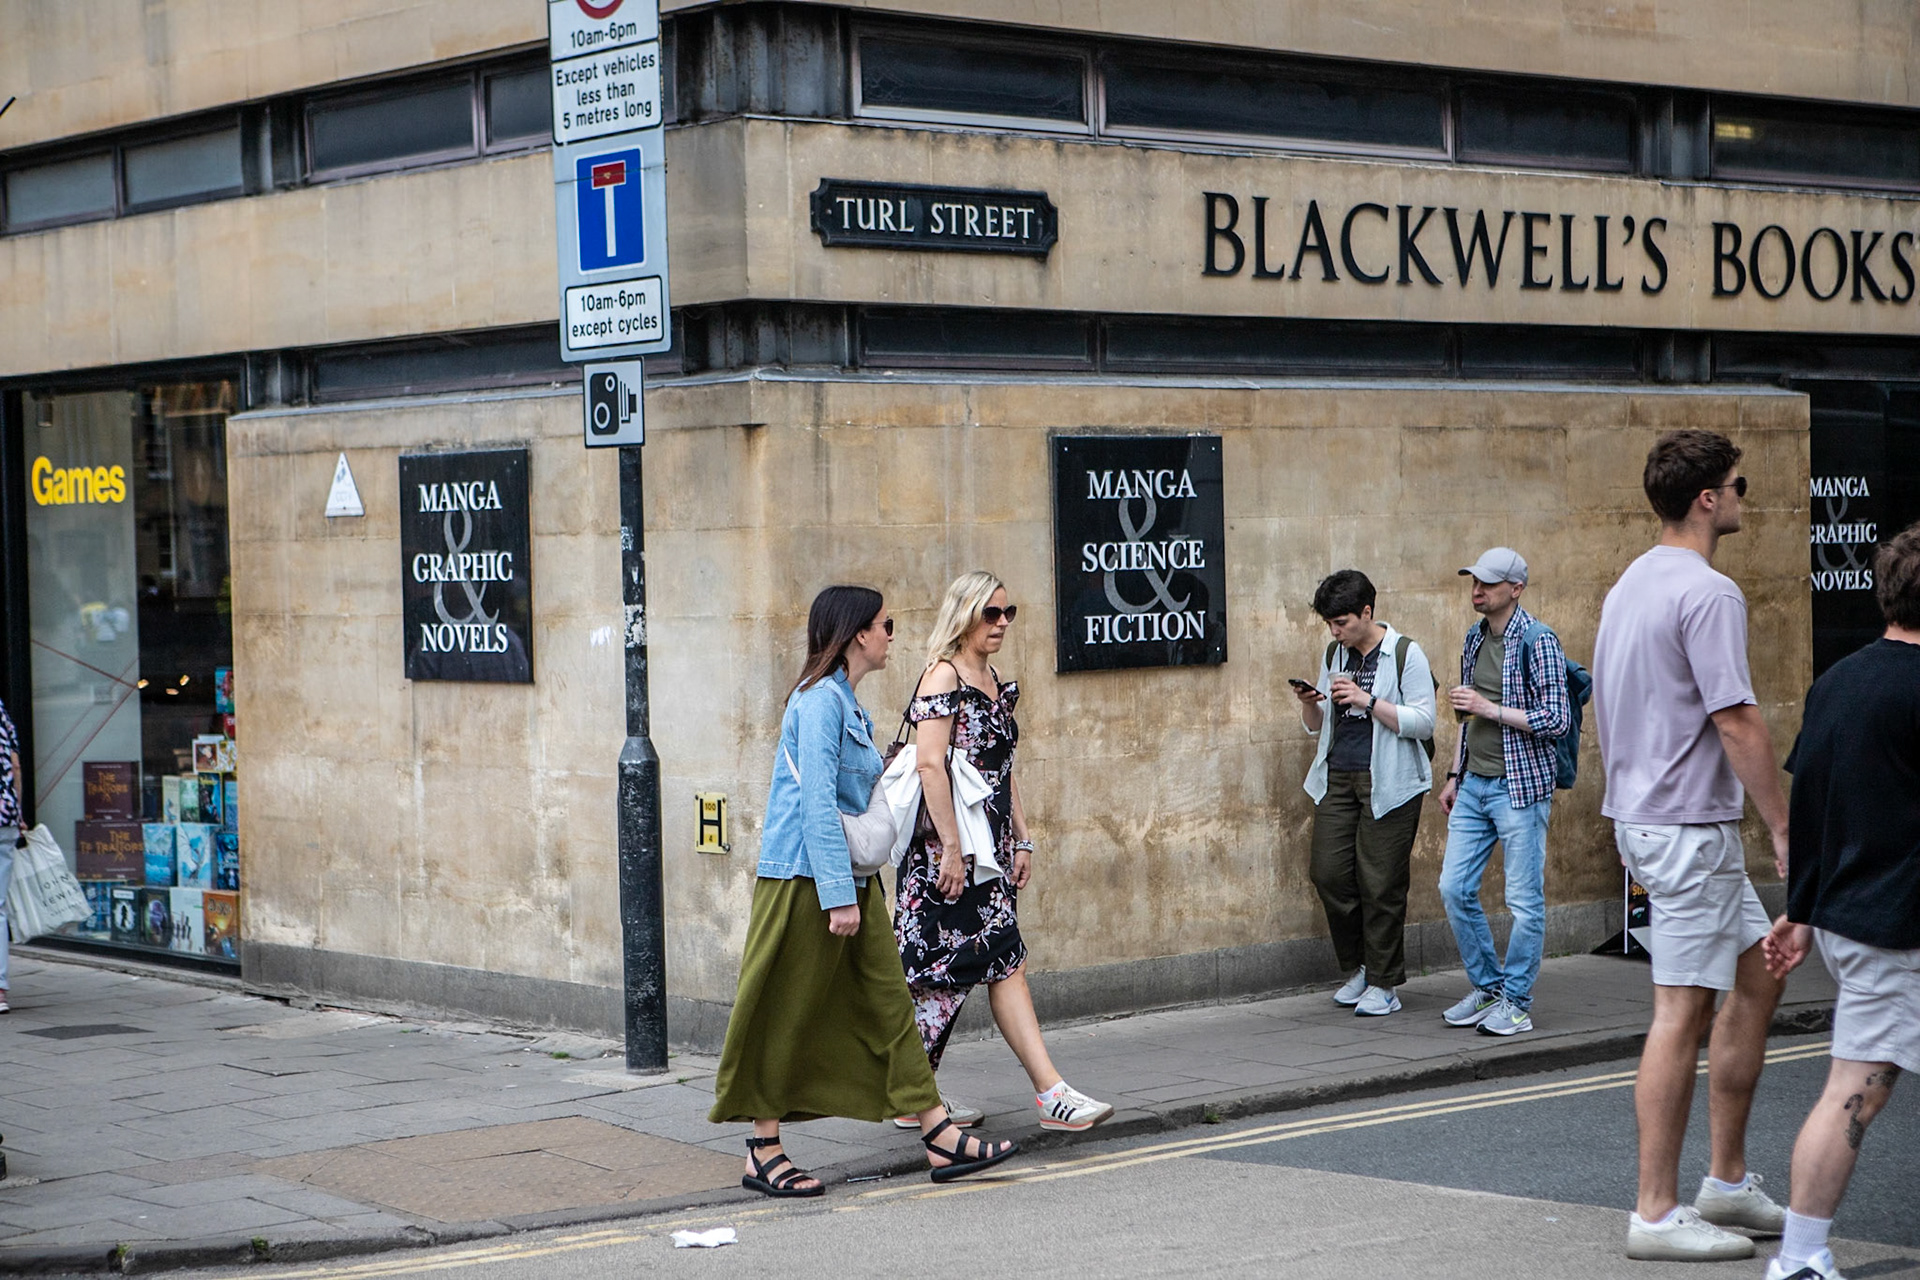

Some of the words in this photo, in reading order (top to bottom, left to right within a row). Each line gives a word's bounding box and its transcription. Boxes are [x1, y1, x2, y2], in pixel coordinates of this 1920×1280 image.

[571, 22, 637, 48] 10am-6pm
[556, 62, 598, 87] Except
[603, 53, 655, 76] vehicles
[577, 89, 601, 106] less
[607, 82, 635, 100] than
[563, 112, 571, 129] 5
[576, 106, 619, 127] metres
[625, 101, 652, 118] long
[836, 197, 916, 233] TURL
[930, 203, 1035, 239] STREET
[581, 290, 646, 312] 10am-6pm
[572, 317, 613, 337] except
[618, 313, 658, 335] cycles
[32, 456, 126, 506] Games
[418, 480, 503, 513] MANGA
[1086, 468, 1197, 499] MANGA
[1810, 476, 1870, 498] MANGA
[412, 551, 514, 583] GRAPHIC
[1081, 540, 1206, 573] SCIENCE
[420, 622, 509, 654] NOVELS
[1084, 610, 1206, 645] FICTION
